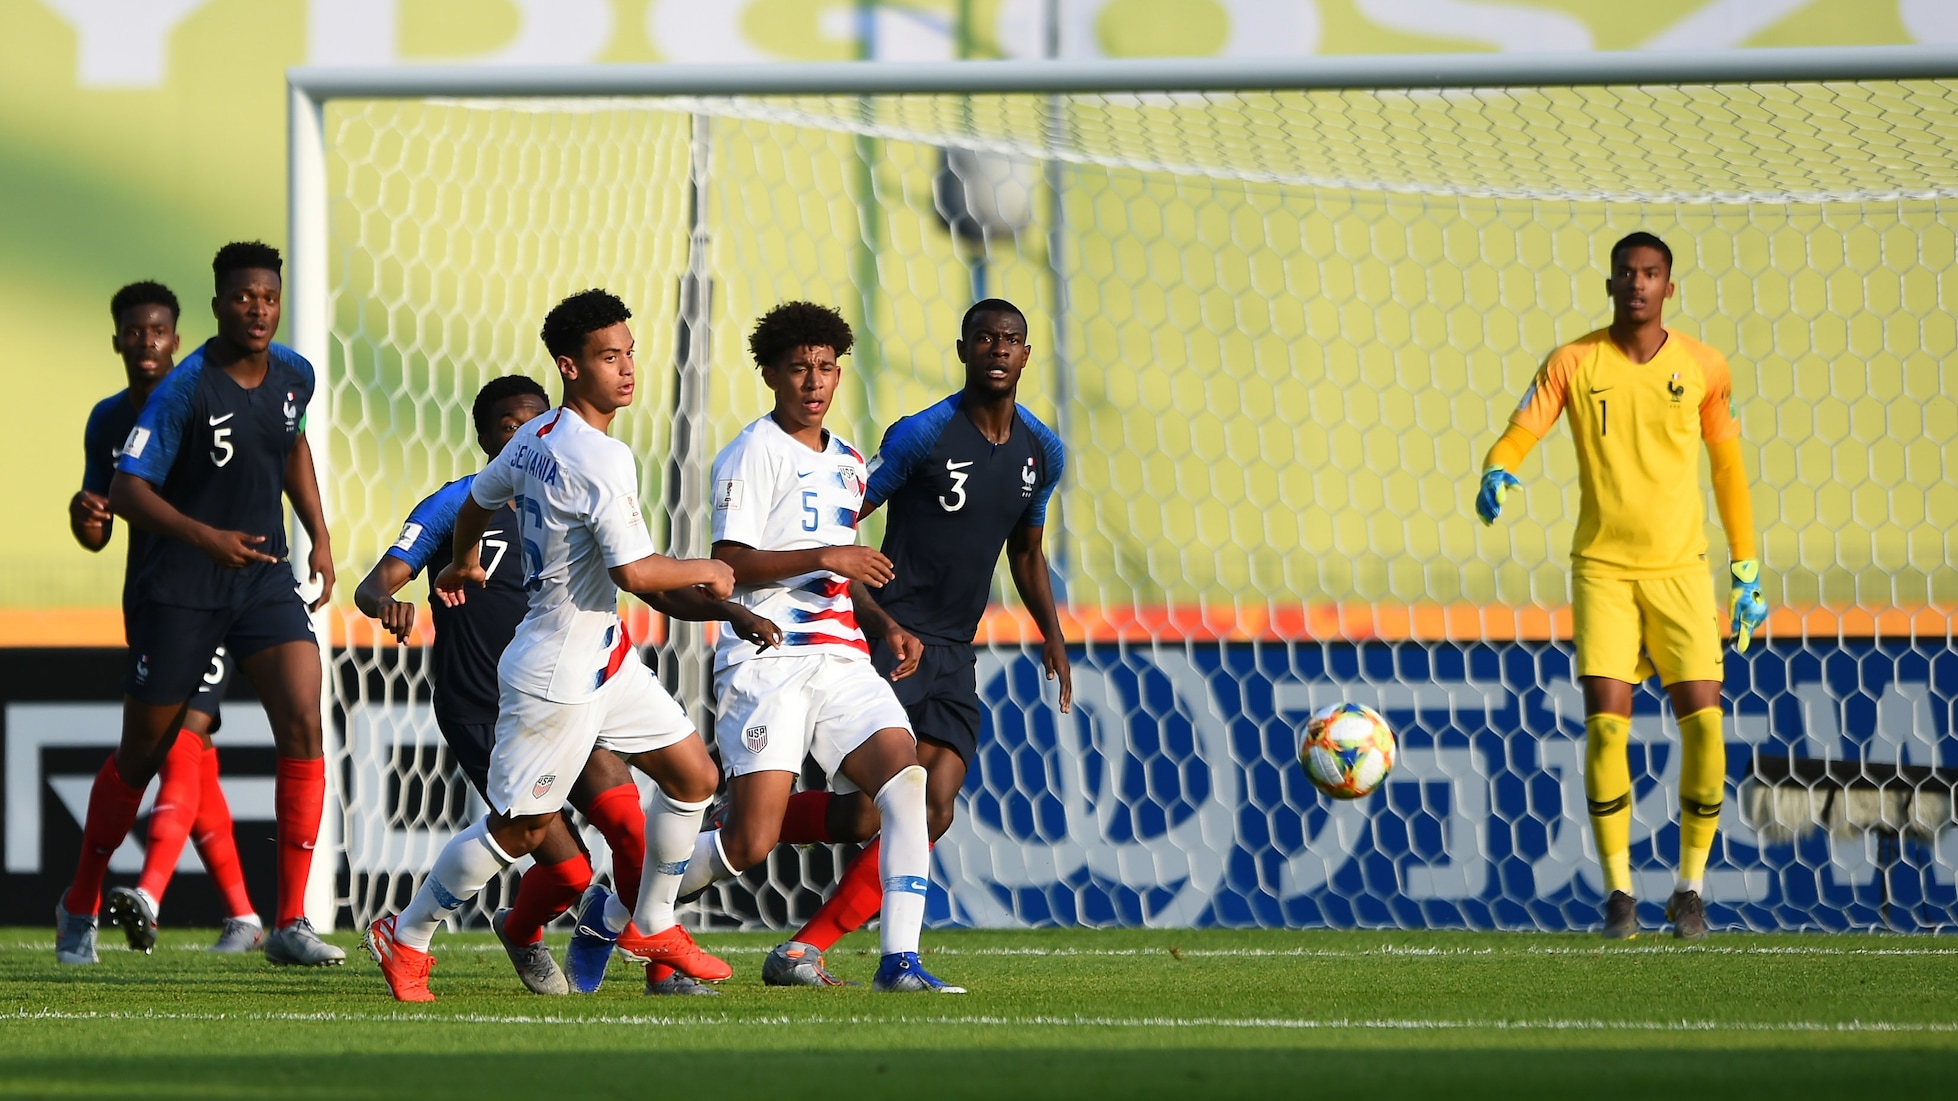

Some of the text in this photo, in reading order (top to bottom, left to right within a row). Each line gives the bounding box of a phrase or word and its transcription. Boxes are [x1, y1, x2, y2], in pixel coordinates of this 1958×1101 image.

[1599, 400, 1607, 437] 1
[210, 428, 234, 468] 5
[938, 470, 969, 512] 3
[802, 491, 819, 532] 5
[748, 727, 766, 738] USA
[537, 774, 555, 786] USA
